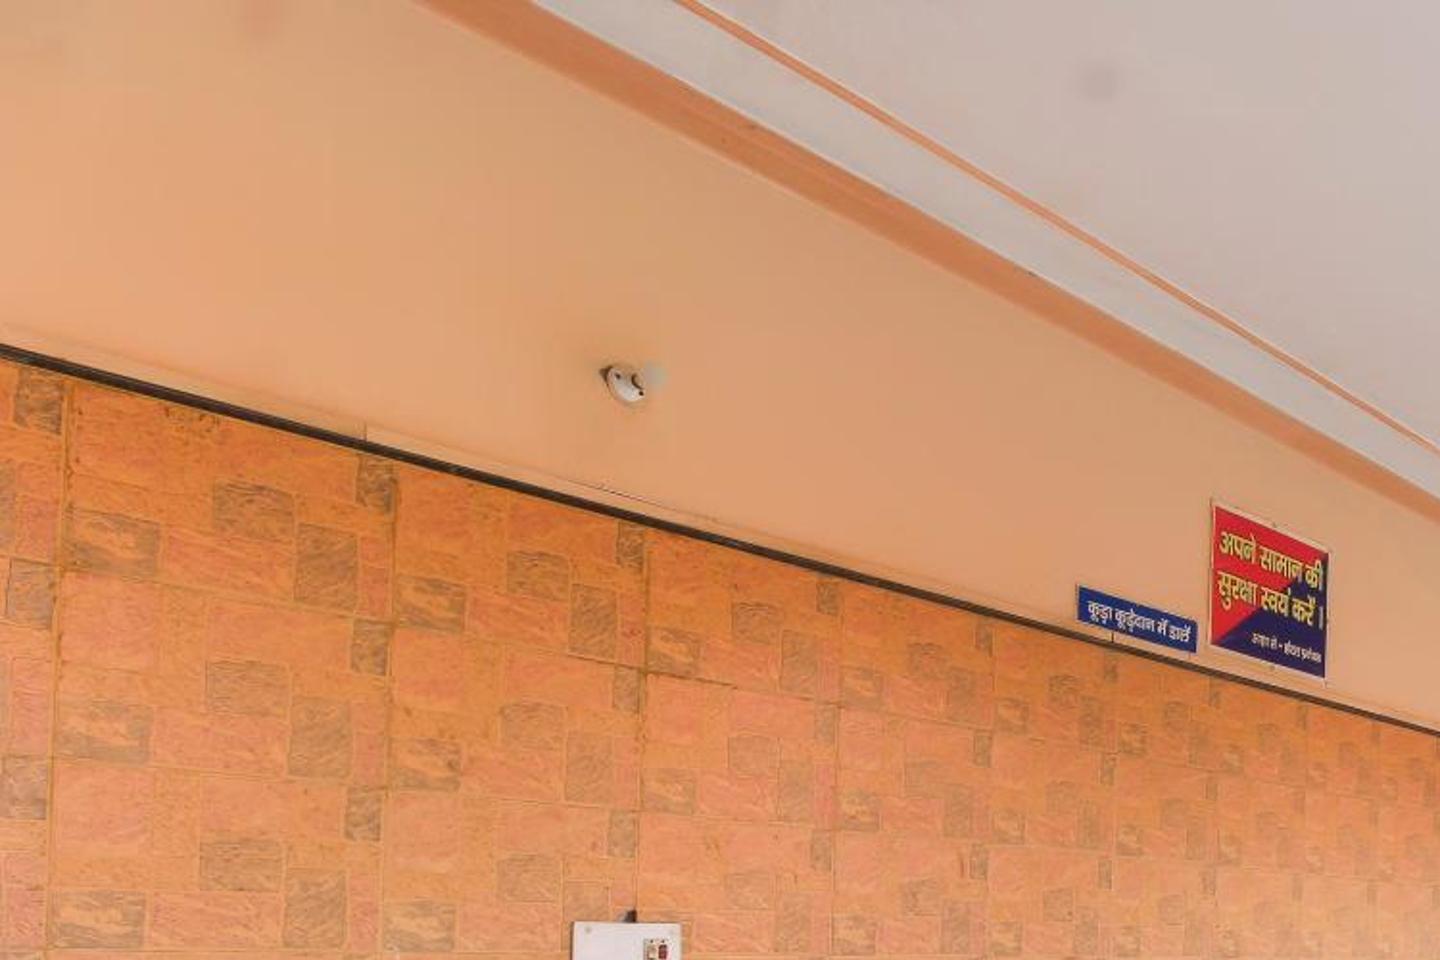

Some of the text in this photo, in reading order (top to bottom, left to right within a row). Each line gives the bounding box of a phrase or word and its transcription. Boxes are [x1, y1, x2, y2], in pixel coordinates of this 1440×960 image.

[1219, 531, 1323, 590] अपने सामान की
[1217, 570, 1258, 611] सुरक्षा
[1261, 587, 1291, 618] स्वयं
[1156, 618, 1168, 636] में
[1168, 624, 1191, 642] डालें
